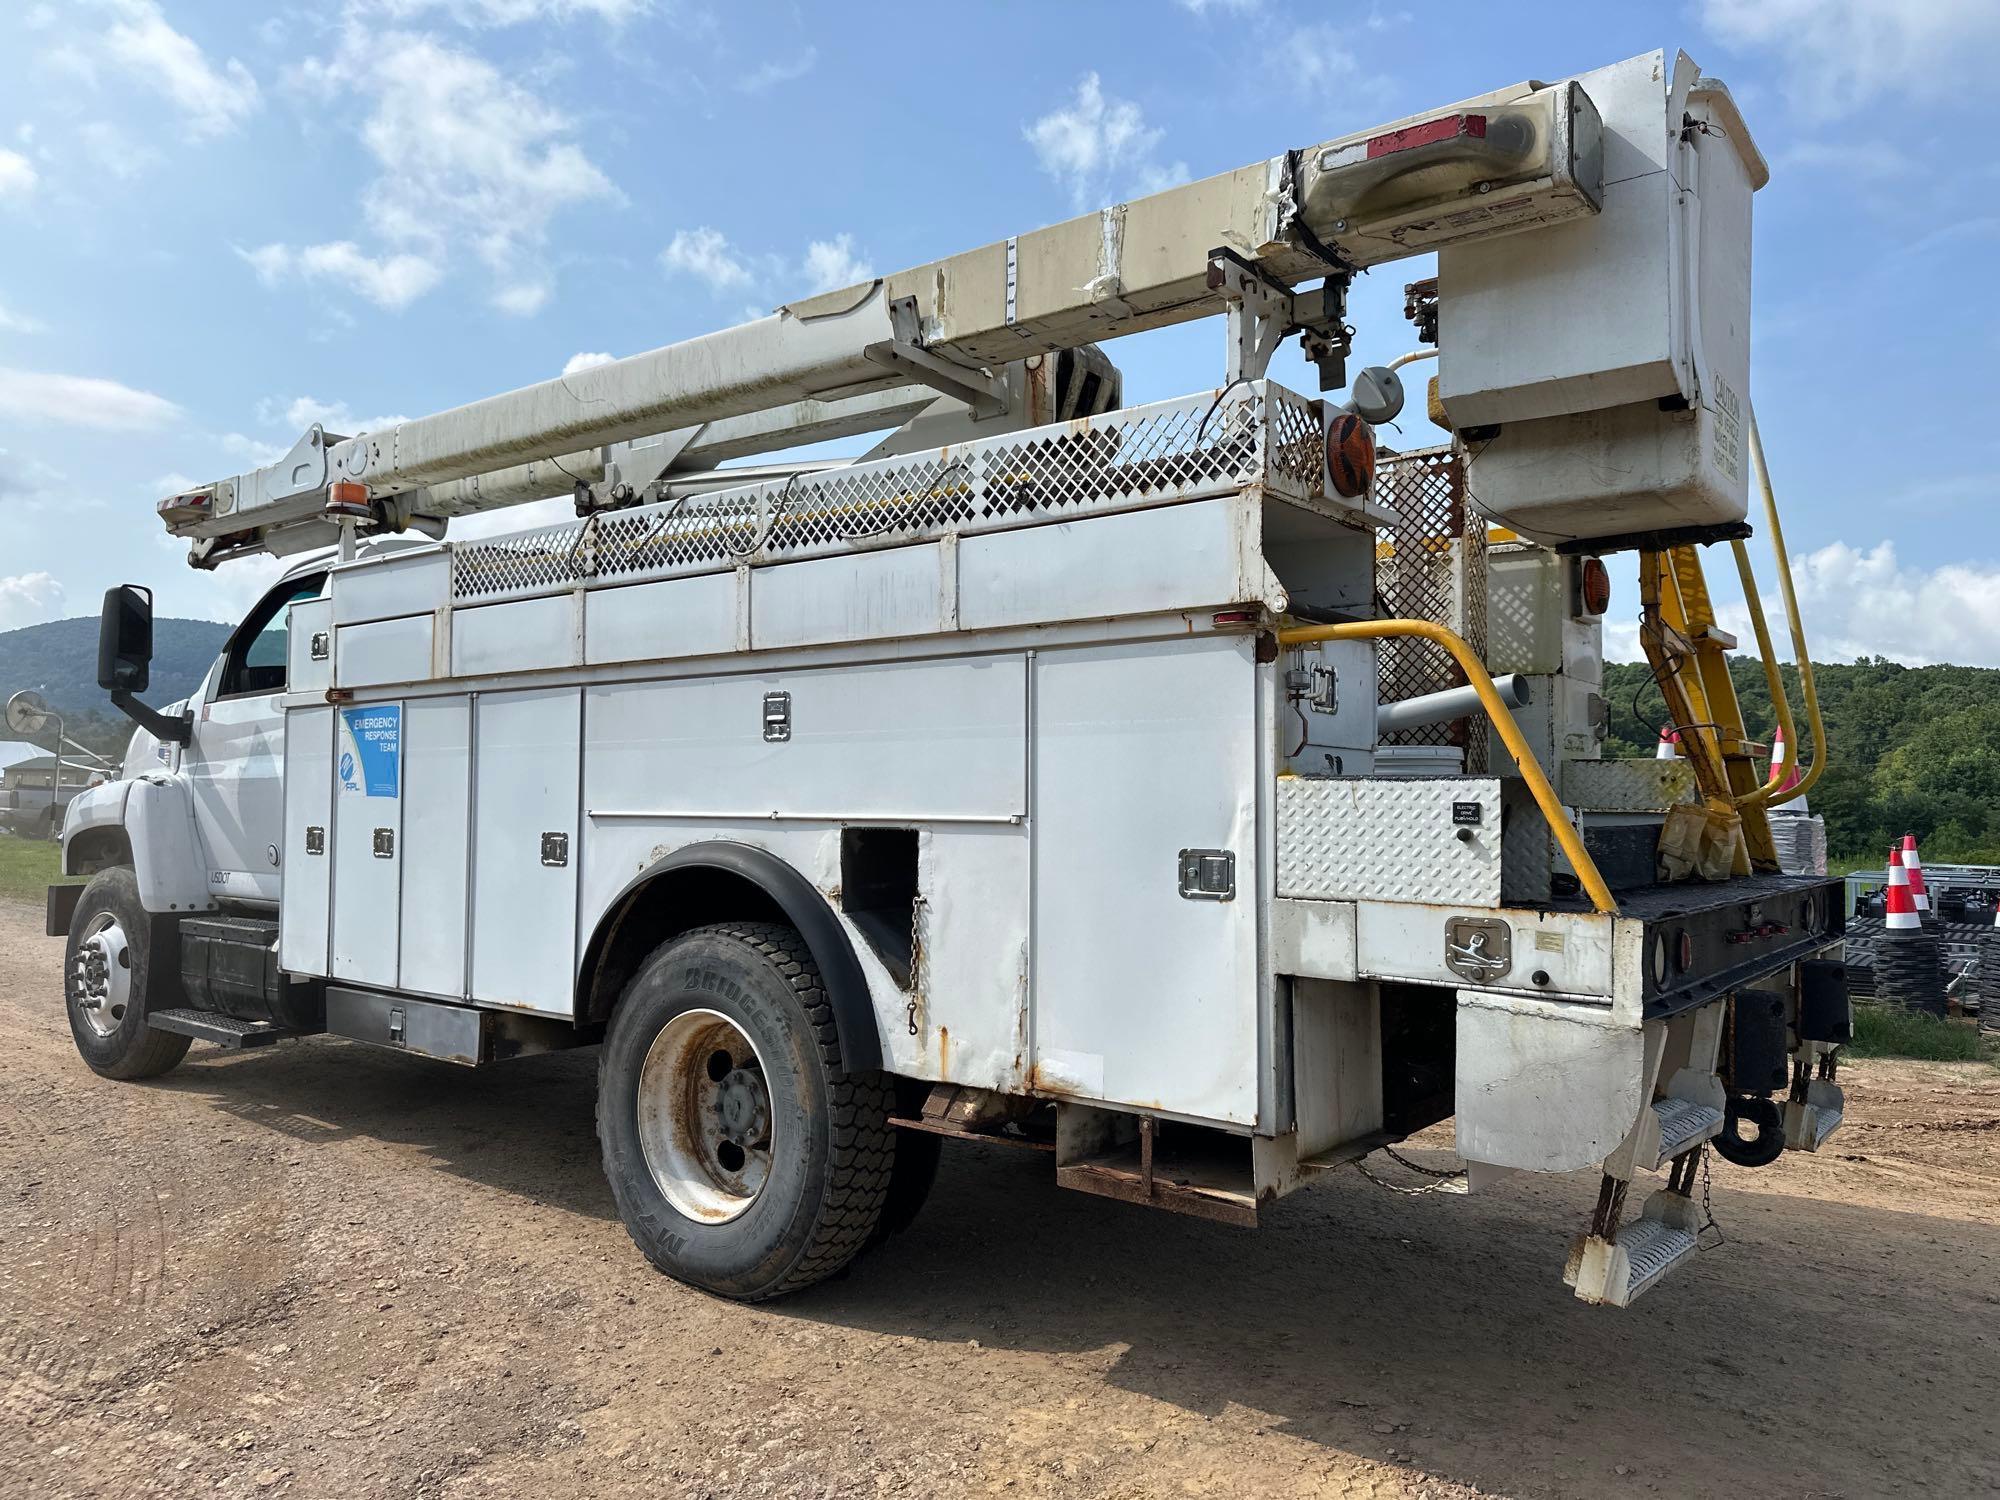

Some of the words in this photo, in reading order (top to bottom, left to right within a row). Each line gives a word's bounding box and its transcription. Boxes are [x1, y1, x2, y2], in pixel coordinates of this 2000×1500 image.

[1714, 374, 1740, 421] CAUTION
[354, 717, 398, 730] EMERGENCY
[364, 730, 397, 741] RESPONSE
[379, 742, 397, 752] TEAM
[211, 871, 231, 884] USDOT
[684, 967, 801, 1140] BRIDGESTONE
